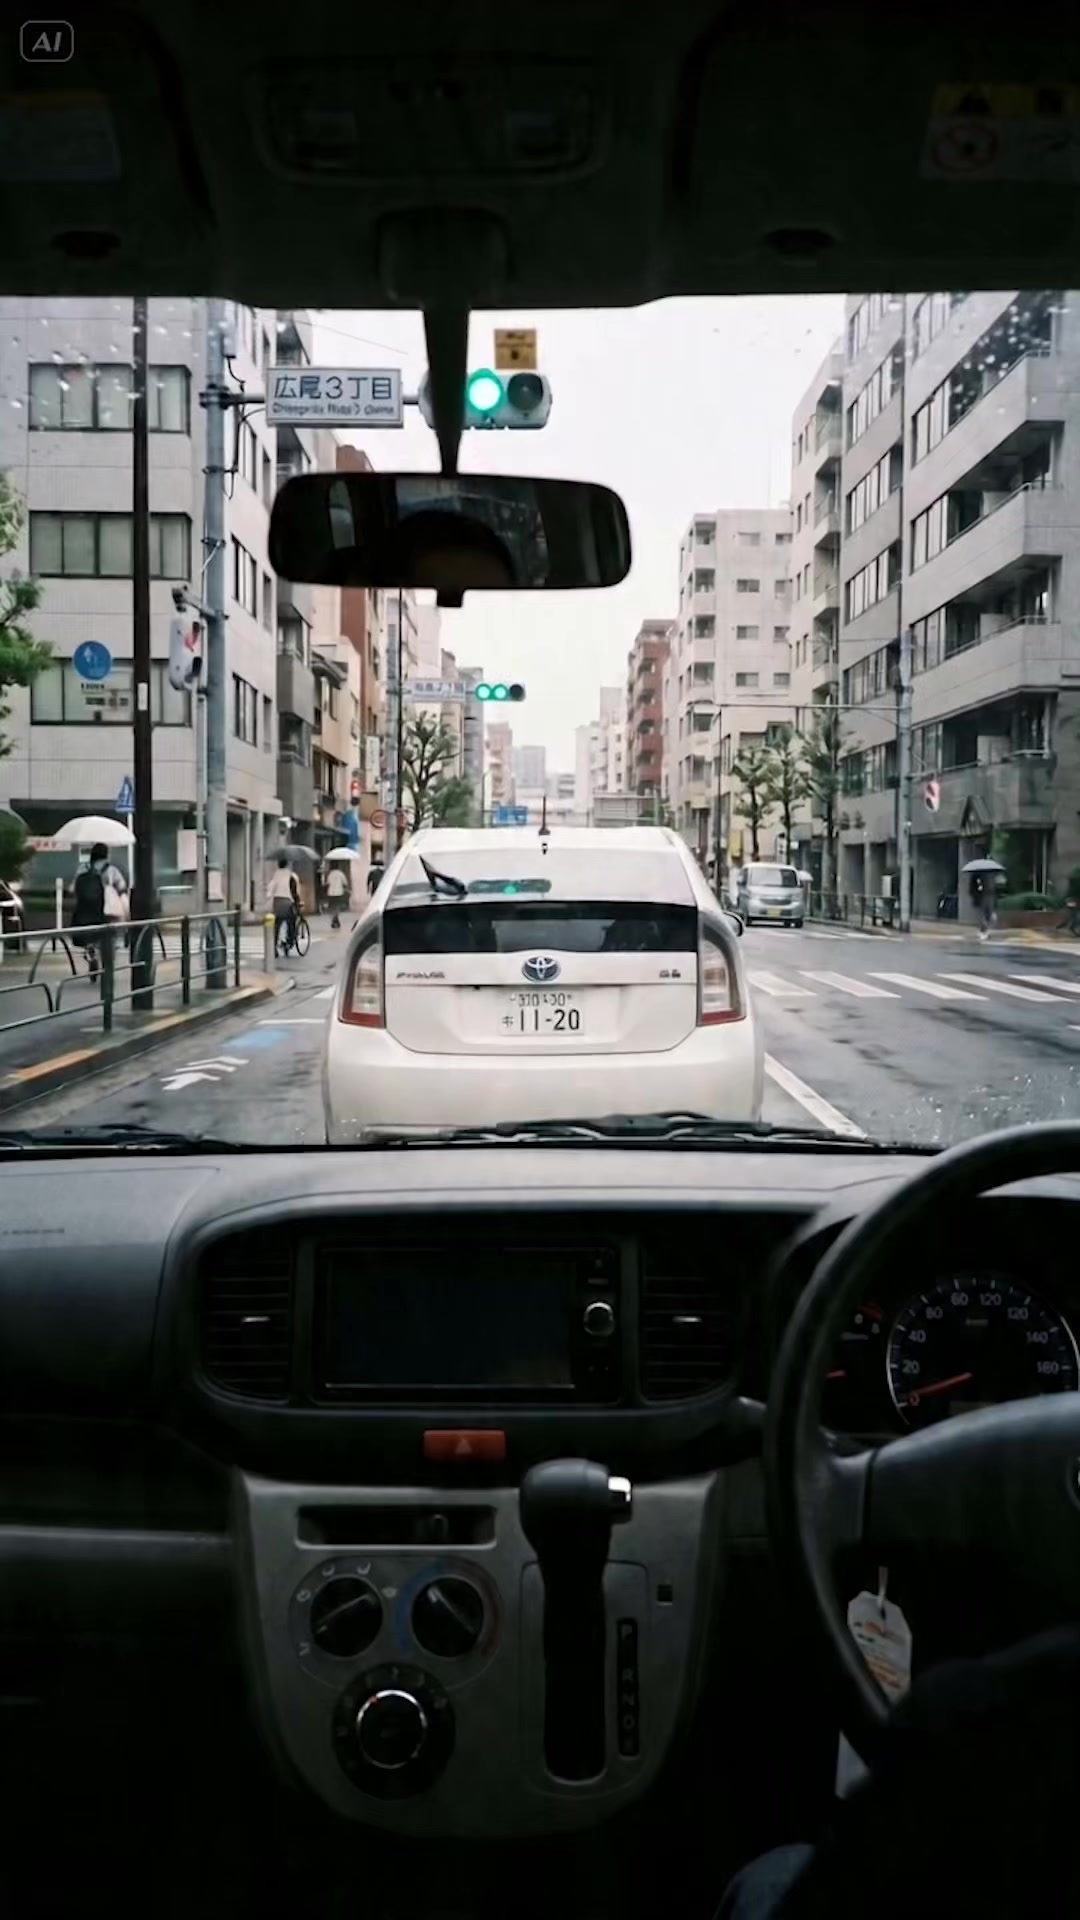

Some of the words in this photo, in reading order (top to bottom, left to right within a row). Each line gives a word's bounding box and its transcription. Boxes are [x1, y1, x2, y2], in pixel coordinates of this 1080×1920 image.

[274, 375, 392, 400] 広尾3丁目
[520, 1008, 580, 1031] 11-20
[908, 1329, 928, 1343] 40
[902, 1360, 920, 1375] 20
